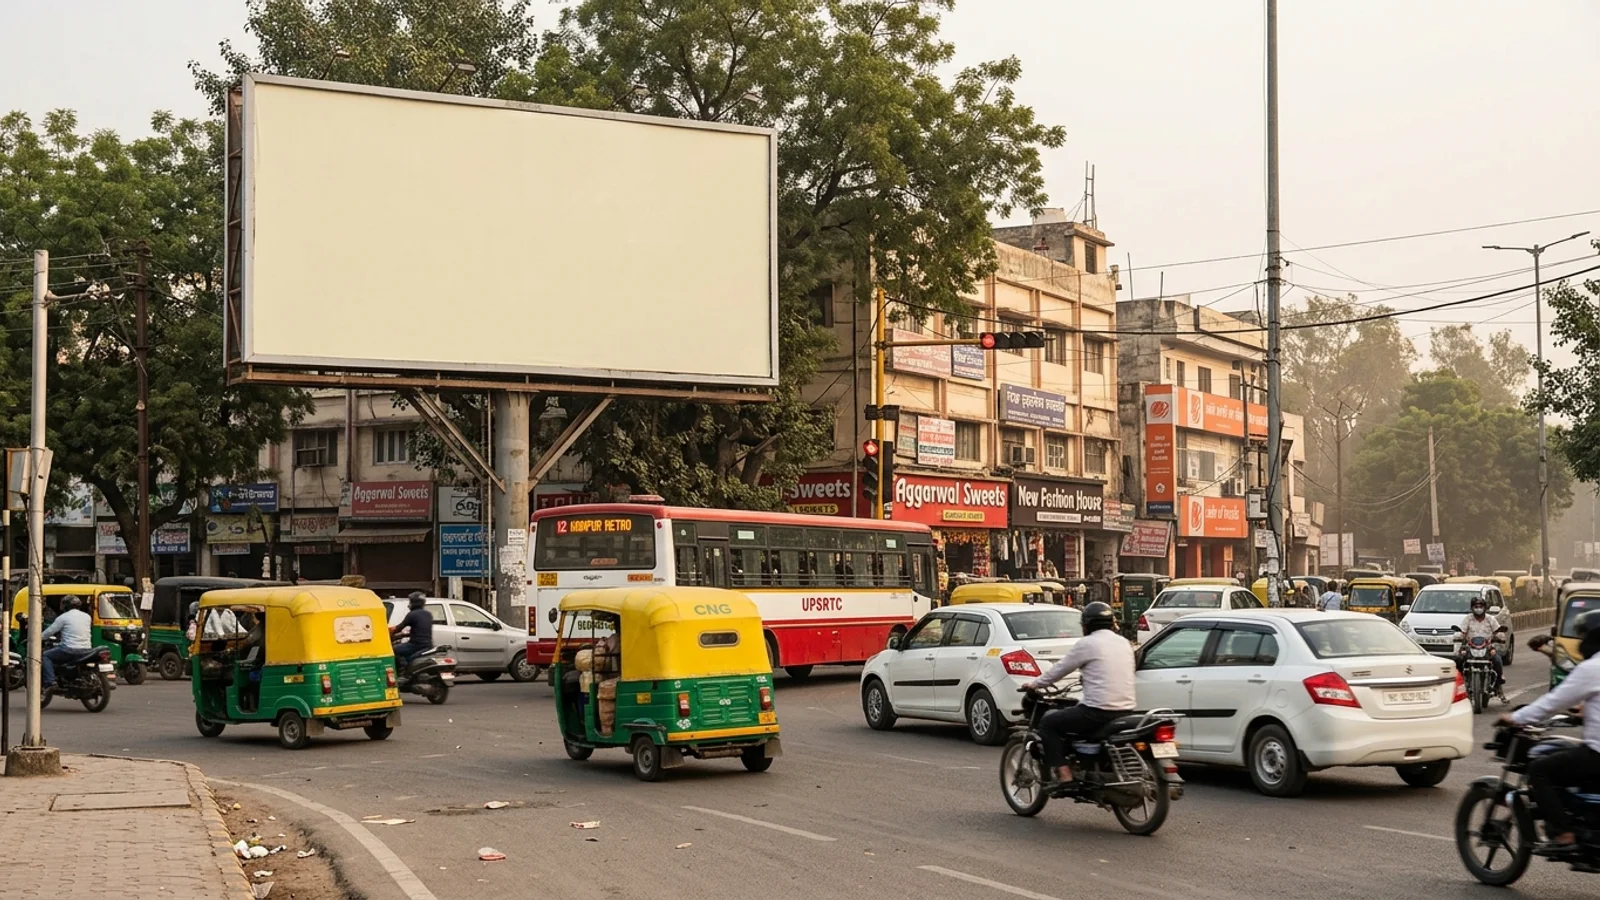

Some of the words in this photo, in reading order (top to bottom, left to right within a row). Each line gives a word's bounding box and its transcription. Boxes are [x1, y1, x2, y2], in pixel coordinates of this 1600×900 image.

[789, 479, 851, 499] Sweets
[895, 477, 959, 508] Aggarwal
[963, 483, 1006, 507] Sweets
[1018, 485, 1039, 507] New
[1076, 490, 1102, 511] House
[557, 520, 567, 533] 12
[694, 603, 732, 616] CNG
[802, 597, 843, 612] UPSRTC
